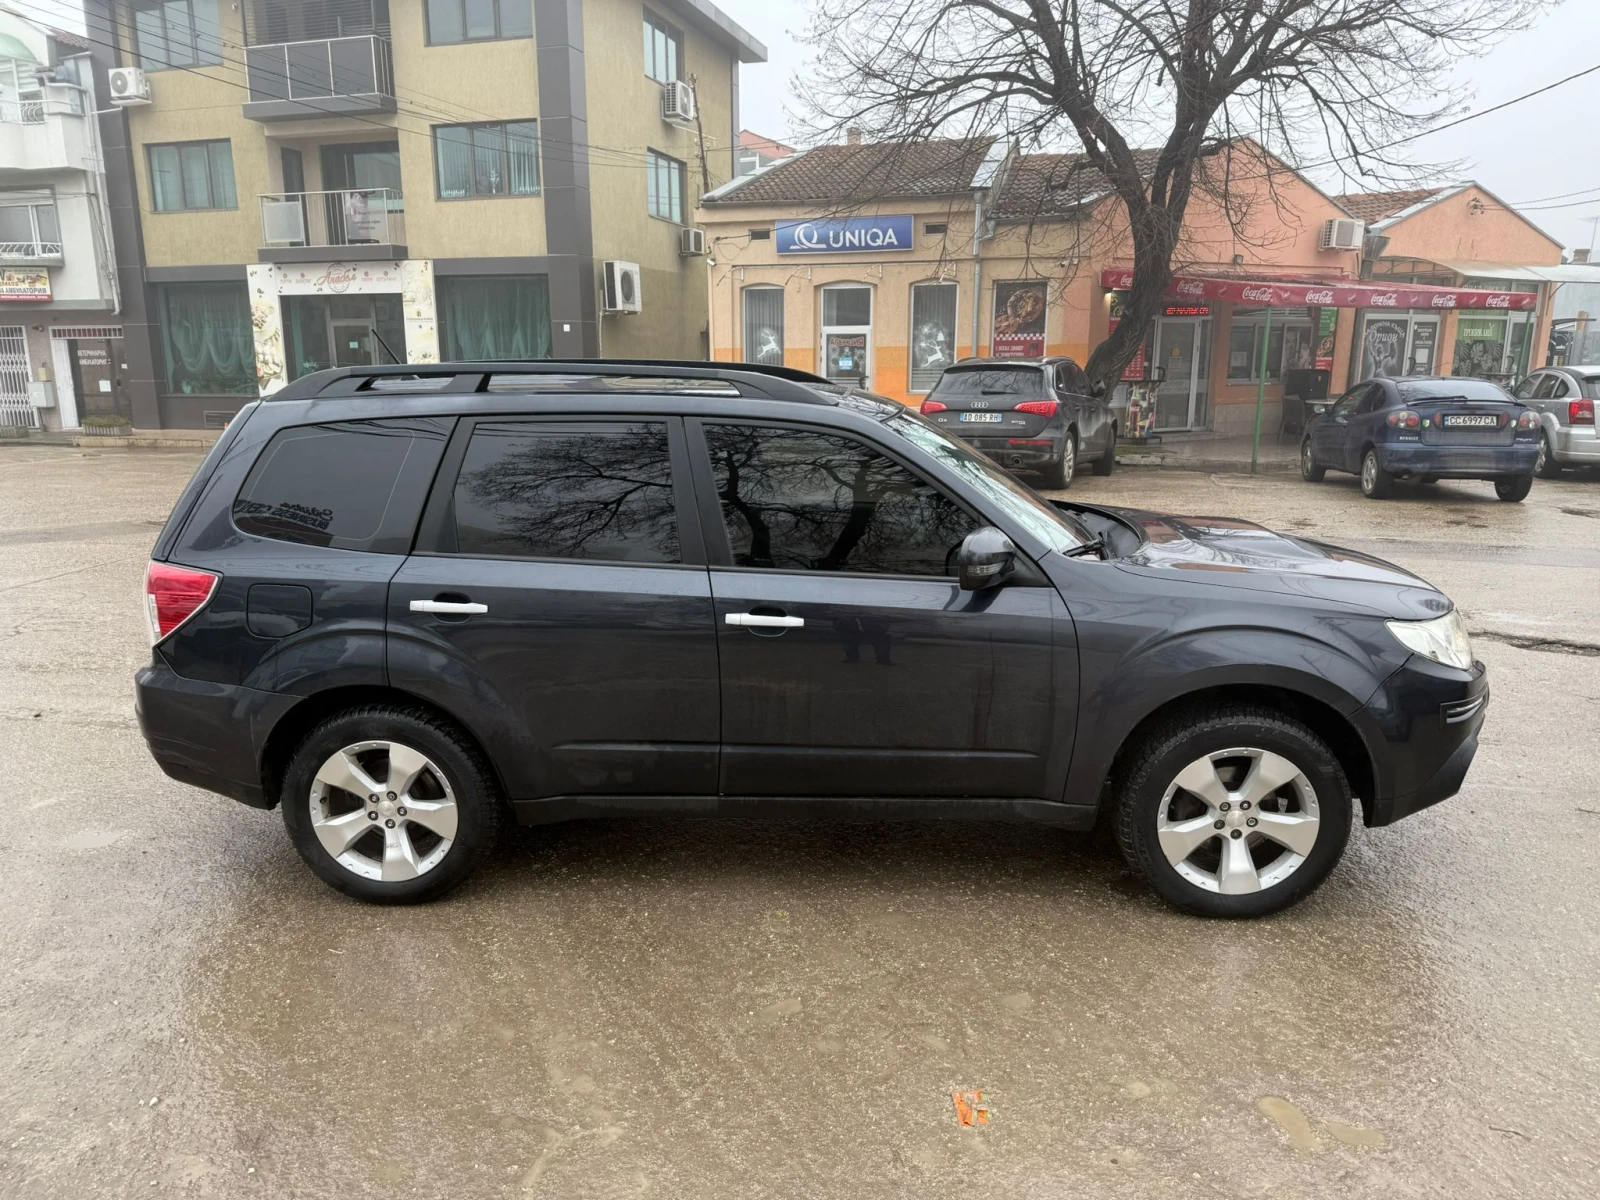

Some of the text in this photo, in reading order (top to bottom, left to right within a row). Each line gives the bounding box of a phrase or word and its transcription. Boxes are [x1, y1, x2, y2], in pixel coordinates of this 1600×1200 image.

[829, 228, 898, 248] UNIQA
[1177, 280, 1204, 295] Coca-Cola
[1242, 286, 1273, 302] Coca-Cola
[1305, 289, 1334, 304] Coca-Cola
[1370, 292, 1398, 306] Coca-Cola
[1431, 294, 1457, 307] Coca-Cola
[1485, 294, 1511, 308] Coca-Cola
[830, 336, 865, 348] АГЕНЦИЯ
[1369, 329, 1398, 346] Орион
[77, 349, 106, 357] ВЕТЕРИНАРНА
[974, 413, 987, 421] 085
[989, 413, 998, 421] RH
